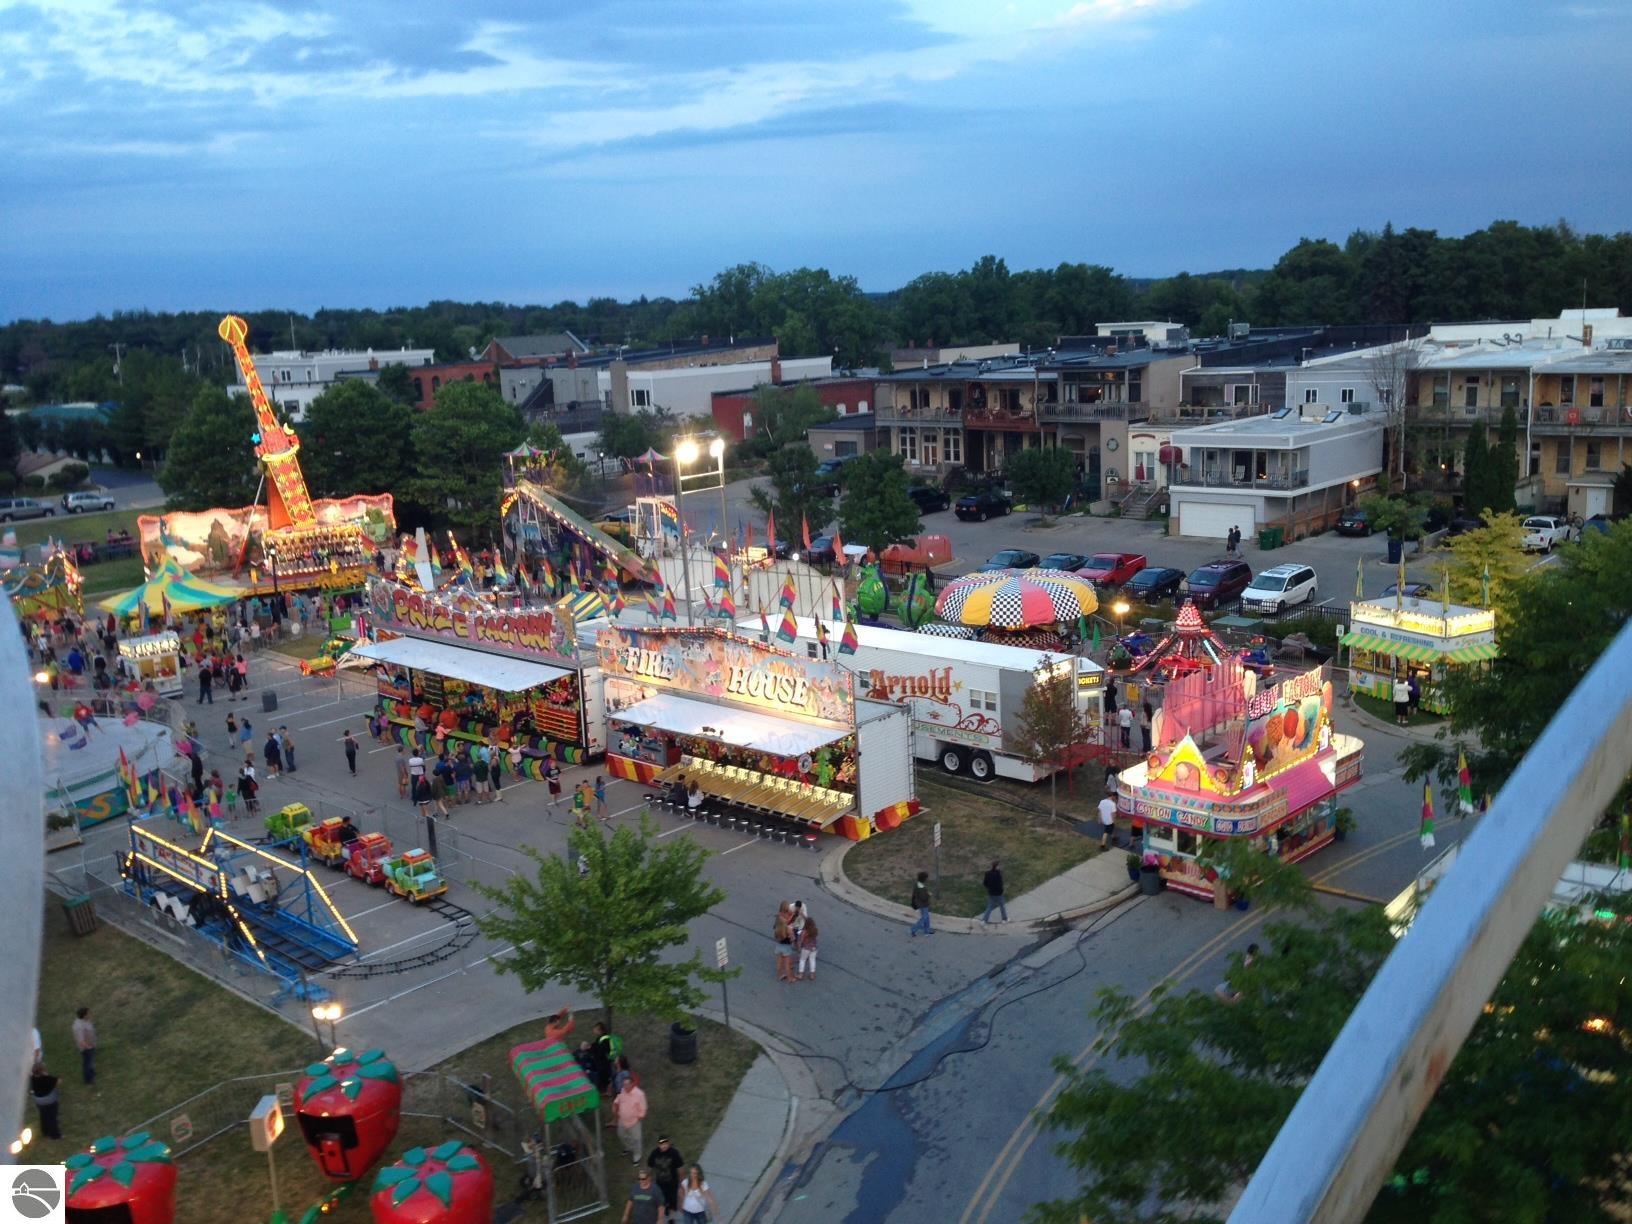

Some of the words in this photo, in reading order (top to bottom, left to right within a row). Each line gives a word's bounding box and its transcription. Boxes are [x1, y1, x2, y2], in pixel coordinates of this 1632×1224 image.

[392, 589, 469, 638] PRIZE
[474, 611, 555, 651] FACTORY
[1360, 626, 1379, 637] COOL
[1390, 632, 1435, 649] REFRESHING
[625, 646, 674, 681] FIRE
[727, 664, 810, 707] HOUSE
[866, 666, 954, 702] Arnold
[1078, 676, 1099, 685] ICKETS
[1137, 802, 1171, 819] COTTON
[1177, 811, 1208, 827] CANDY
